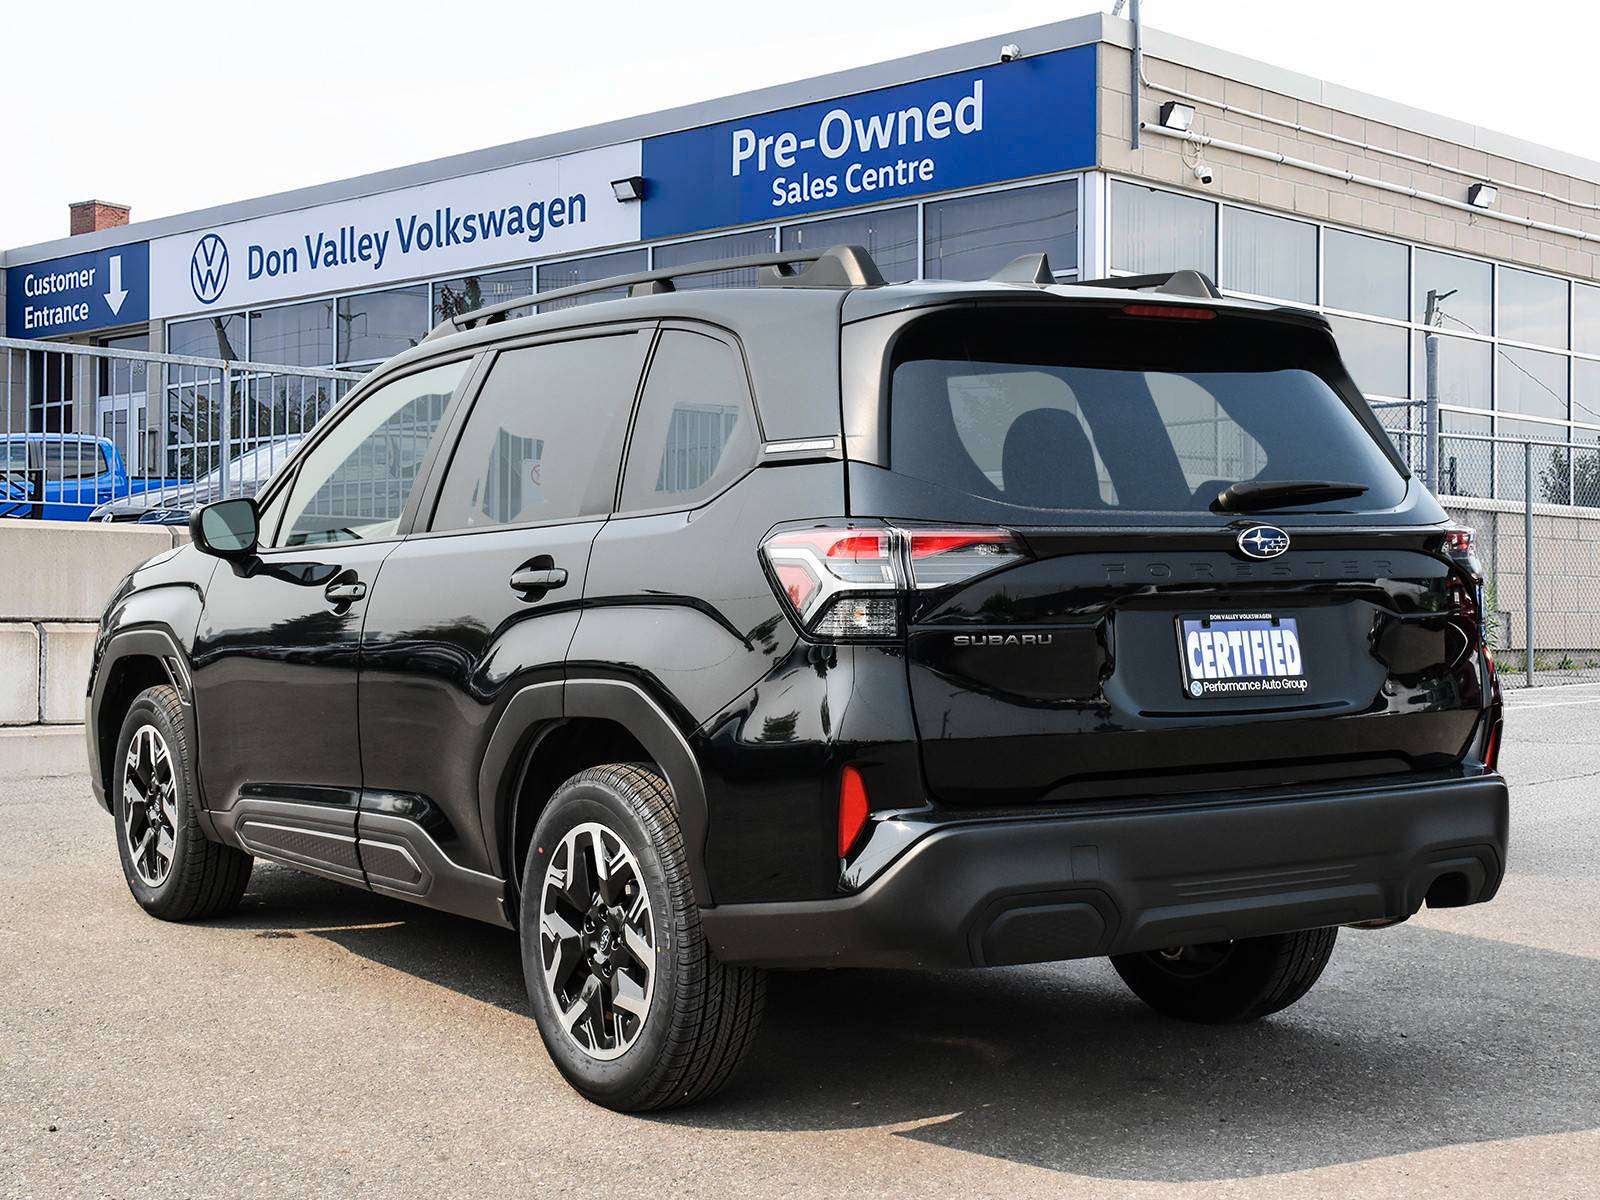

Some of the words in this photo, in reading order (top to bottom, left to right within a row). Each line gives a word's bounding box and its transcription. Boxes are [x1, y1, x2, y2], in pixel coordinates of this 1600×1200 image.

[732, 79, 983, 177] Pre-Owned
[772, 172, 838, 207] Sales
[845, 158, 934, 193] Centre
[248, 245, 298, 281] Don
[304, 226, 390, 269] Valley
[395, 193, 587, 254] Volkswagen
[24, 268, 96, 297] Customer
[24, 302, 89, 329] Entrance
[1101, 560, 1393, 580] FORESTER
[953, 634, 1053, 647] SUBARU
[1187, 630, 1303, 678] CERTIFIED
[1203, 681, 1261, 693] Performance
[1261, 679, 1281, 690] Auto
[1281, 678, 1308, 692] Group
